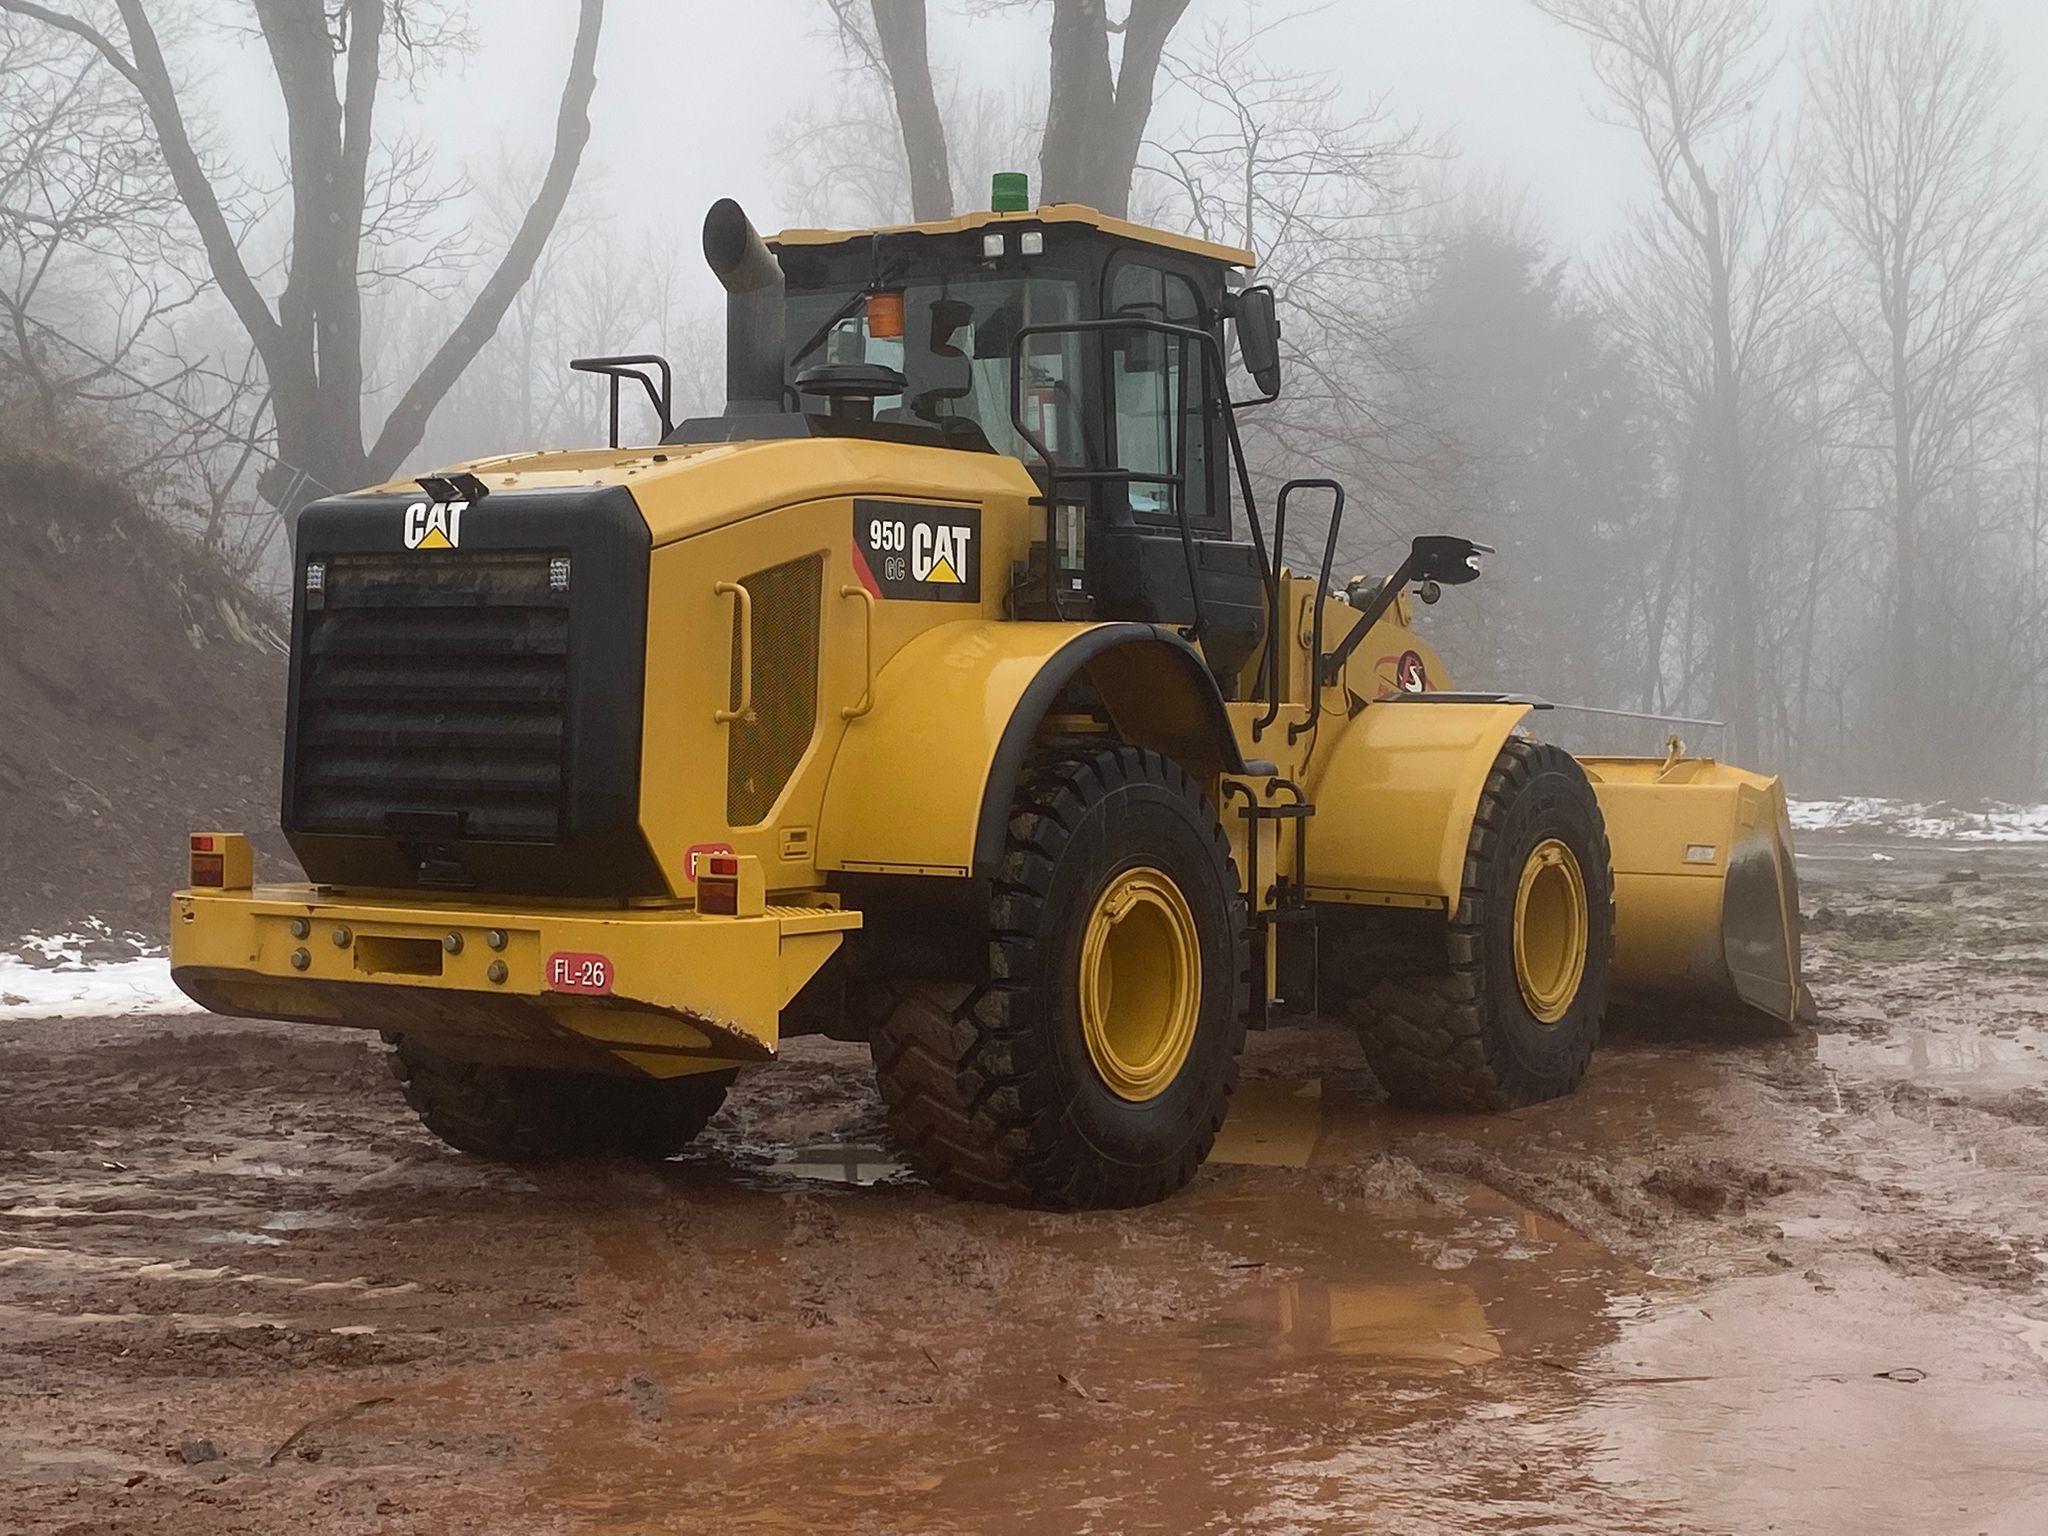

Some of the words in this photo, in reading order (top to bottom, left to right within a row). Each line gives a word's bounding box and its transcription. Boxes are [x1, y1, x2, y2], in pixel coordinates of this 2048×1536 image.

[404, 502, 469, 549] CAT
[870, 519, 905, 551] 950
[885, 557, 905, 580] GC
[912, 523, 971, 583] CAT
[554, 959, 604, 987] FL-26
